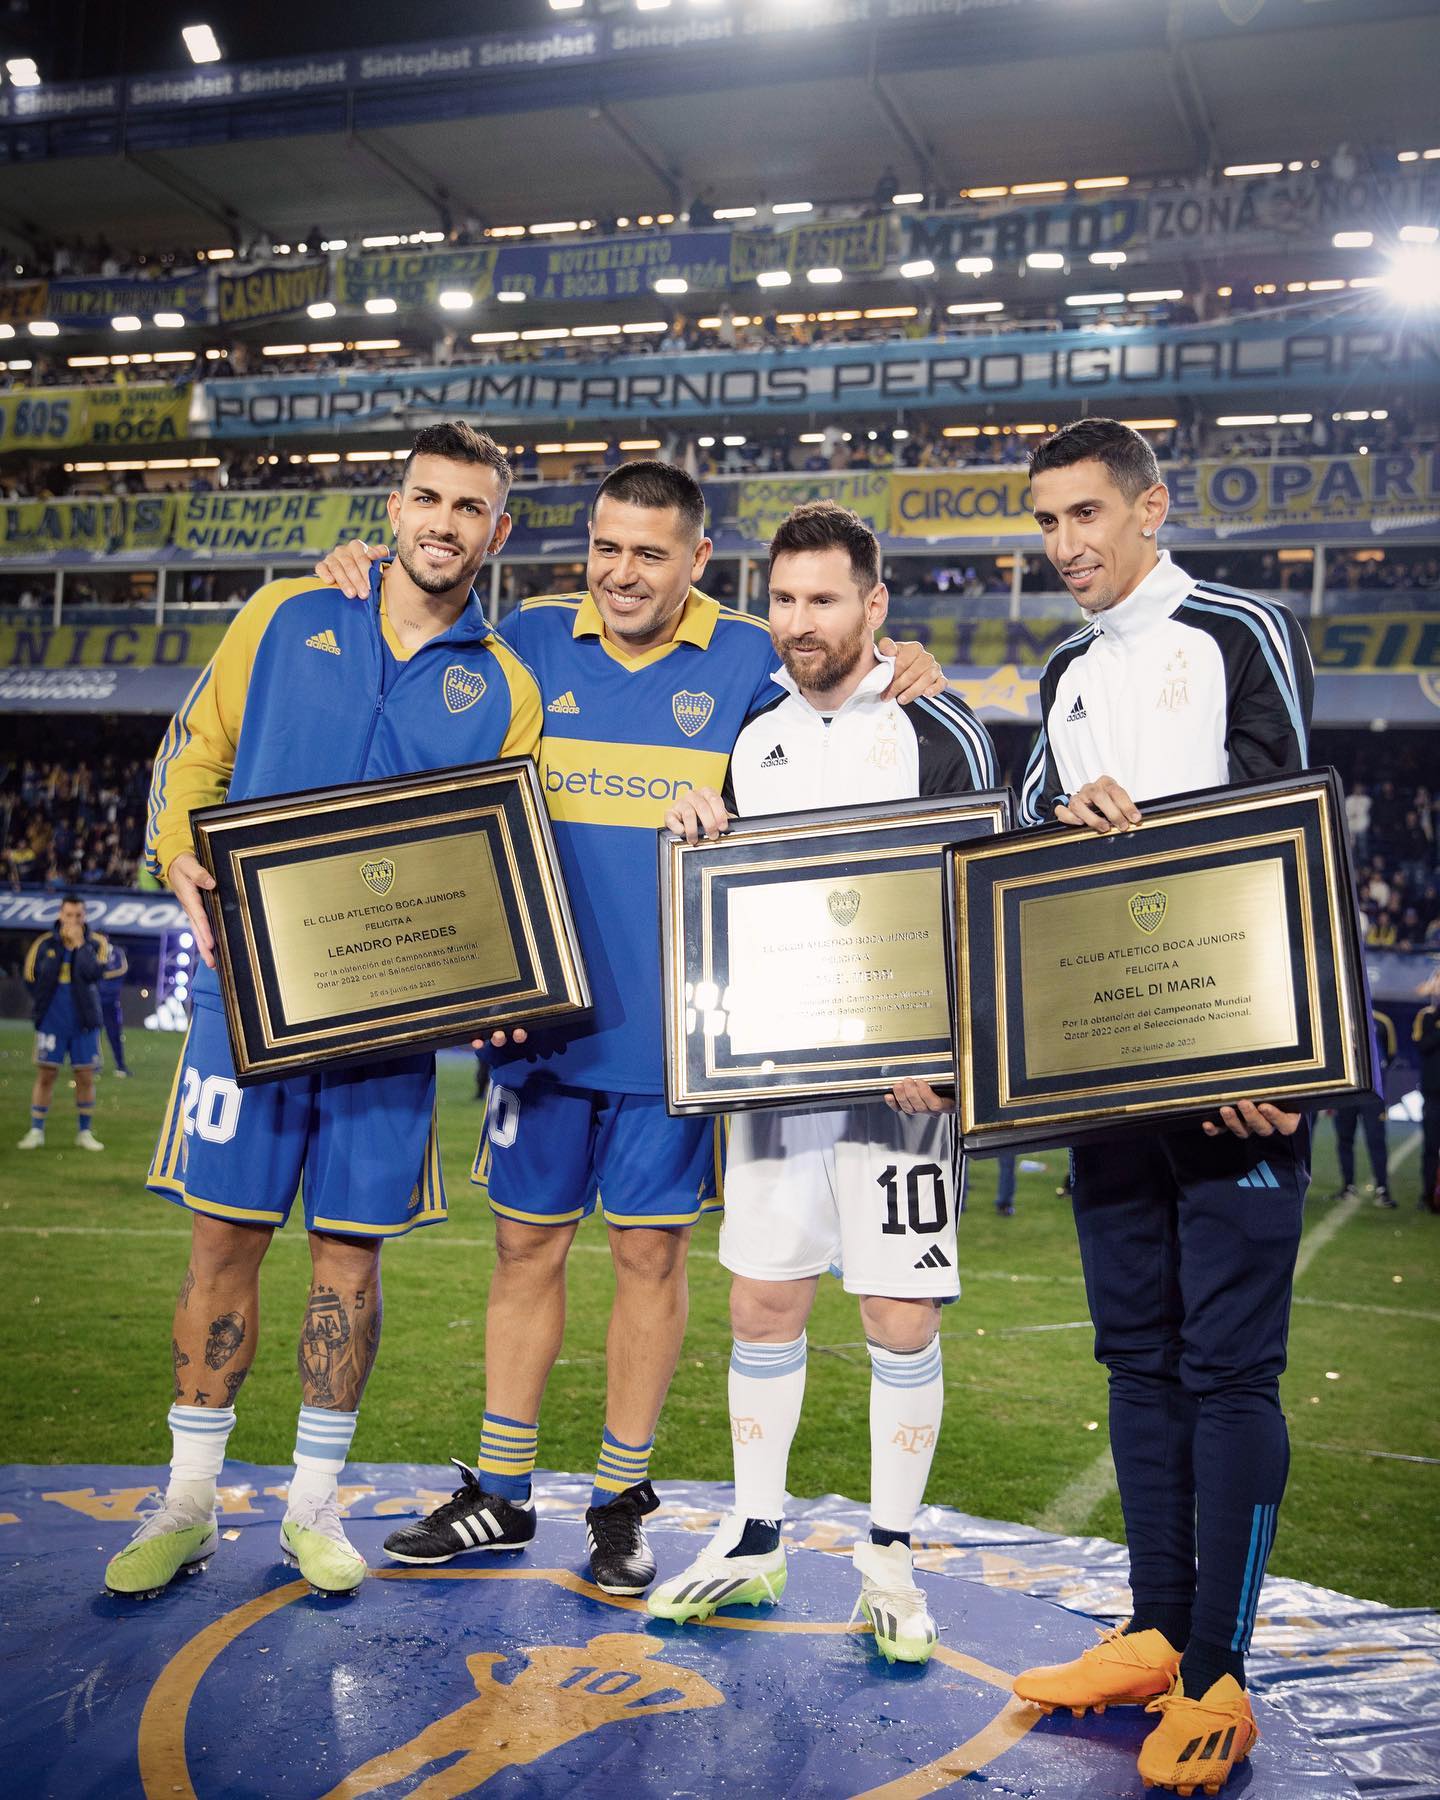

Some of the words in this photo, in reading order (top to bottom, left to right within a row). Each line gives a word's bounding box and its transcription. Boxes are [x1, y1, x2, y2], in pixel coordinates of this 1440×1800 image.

[361, 49, 471, 78] Sinteplast
[480, 33, 597, 65] Sinteplast
[131, 73, 234, 104] Sinteplast
[240, 62, 346, 92] Sinteplast
[15, 86, 114, 115] Sinteplast
[911, 204, 1101, 257] MERLO
[563, 267, 608, 298] BOCA
[466, 366, 808, 411] IMITARNOS
[834, 352, 1023, 400] PERO
[92, 416, 178, 441] BOCA
[1166, 455, 1440, 512] EOPAR
[187, 496, 323, 521] SIEMPRE
[187, 526, 308, 547] NUNCA
[306, 637, 342, 656] adidas
[447, 677, 479, 698] CABJ
[547, 704, 580, 714] adidas
[676, 704, 708, 716] CABJ
[1066, 710, 1087, 722] adidas
[760, 757, 788, 768] adidas
[304, 918, 317, 927] EL
[318, 912, 345, 924] CLUB
[347, 903, 394, 918] ATLETICO
[395, 898, 423, 909] BOCA
[425, 890, 466, 904] JUNIORS
[365, 918, 404, 931] FELICITA
[405, 916, 412, 924] A
[886, 930, 929, 942] JUNIORS
[328, 937, 393, 958] LEANDRO
[395, 925, 457, 946] PAREDES
[1060, 958, 1073, 967] EL
[1076, 952, 1105, 965] CLUB
[1107, 944, 1160, 960] ATLETICO
[1163, 939, 1194, 951] BOCA
[1197, 931, 1246, 946] JUNIORS
[1125, 962, 1170, 975] FELICITA
[1172, 960, 1179, 968] A
[317, 980, 340, 989] Qatar
[341, 975, 360, 984] 2022
[1093, 986, 1144, 1004] ANGEL
[1148, 983, 1163, 996] DI
[1167, 975, 1216, 993] MARIA
[1062, 1020, 1077, 1028] Por
[1080, 1018, 1088, 1026] la
[1137, 1009, 1151, 1018] del
[1154, 1001, 1212, 1016] Campeonato
[1214, 995, 1251, 1007] Mundial
[1091, 1026, 1112, 1037] 2022
[1114, 1025, 1131, 1034] con
[1144, 1014, 1205, 1029] Seleccionado
[183, 1066, 243, 1144] 20
[876, 1163, 948, 1235] 10
[354, 1290, 366, 1309] 5
[314, 1314, 340, 1339] AFA
[892, 1422, 935, 1455] AFA
[558, 1666, 642, 1695] 10
